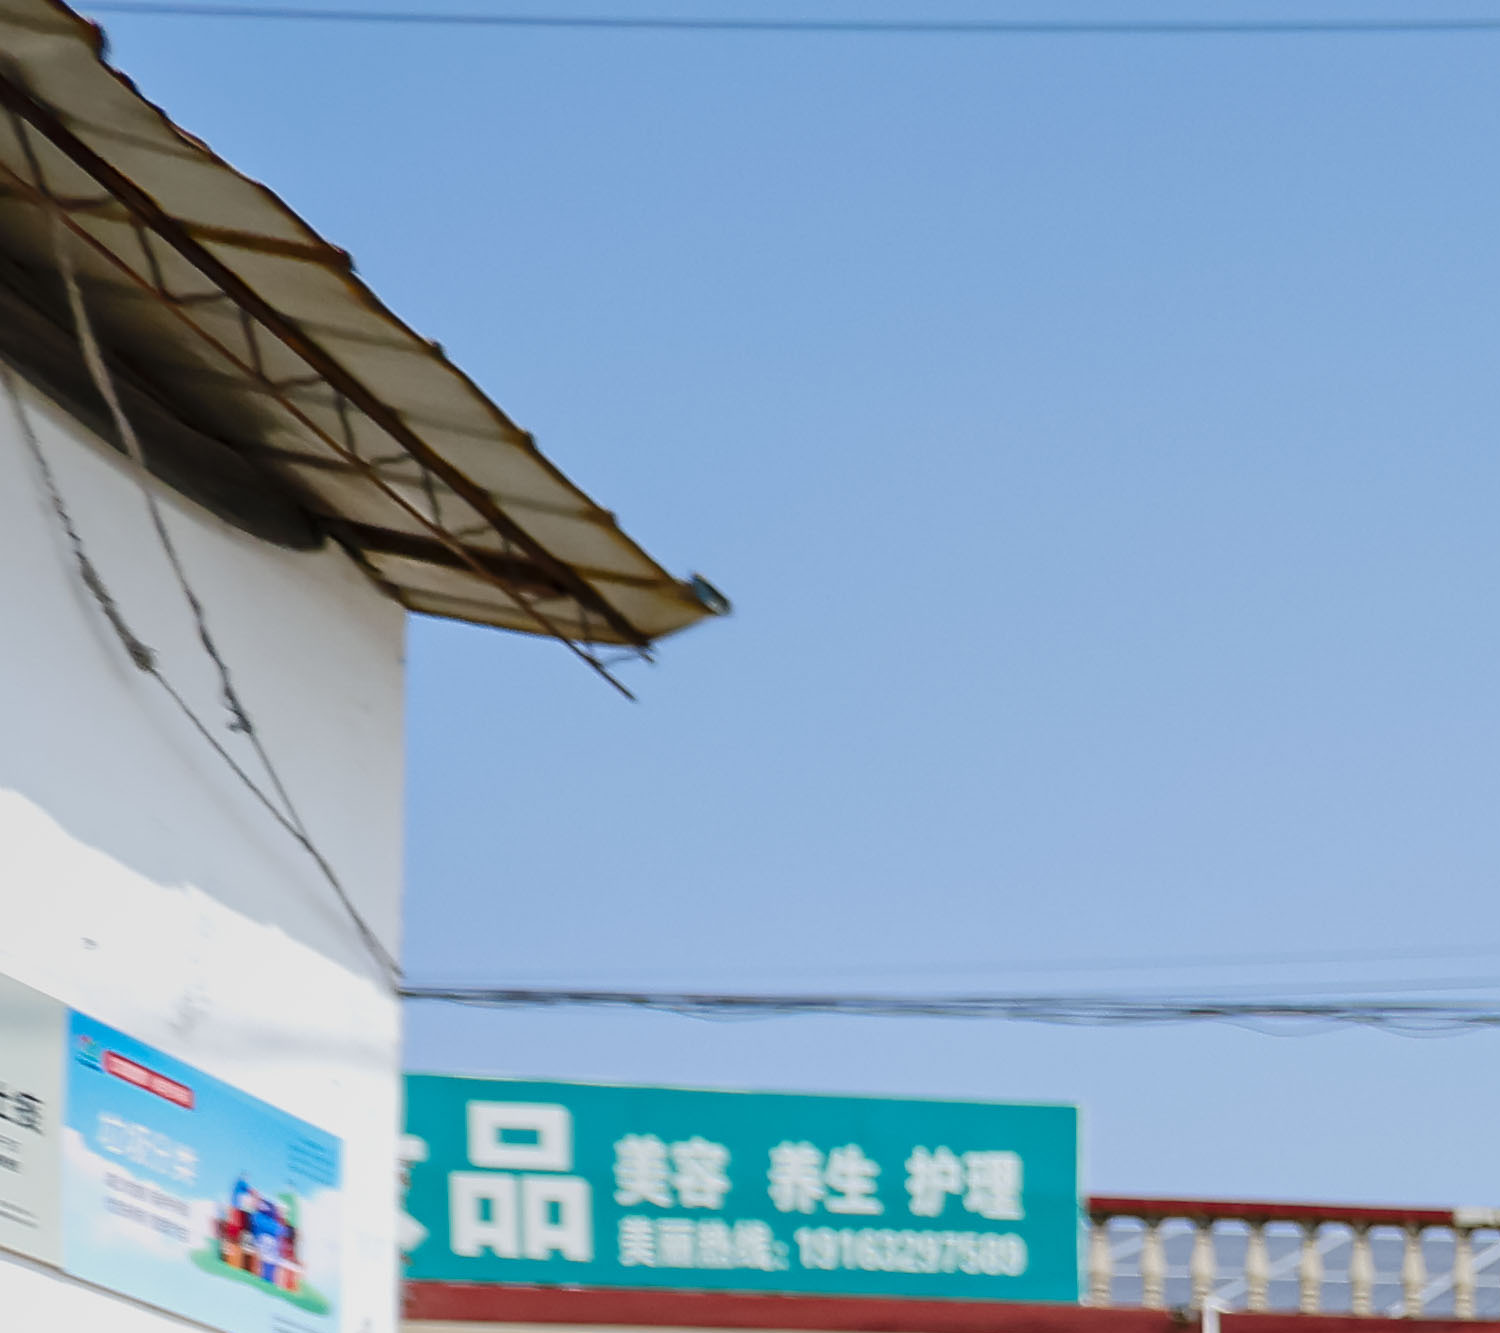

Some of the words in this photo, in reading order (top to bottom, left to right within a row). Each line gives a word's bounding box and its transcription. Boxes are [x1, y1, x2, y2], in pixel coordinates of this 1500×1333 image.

[402, 1099, 593, 1262] 品
[613, 1133, 732, 1210] 美容
[767, 1140, 885, 1216] 养生
[904, 1145, 1025, 1221] 护理
